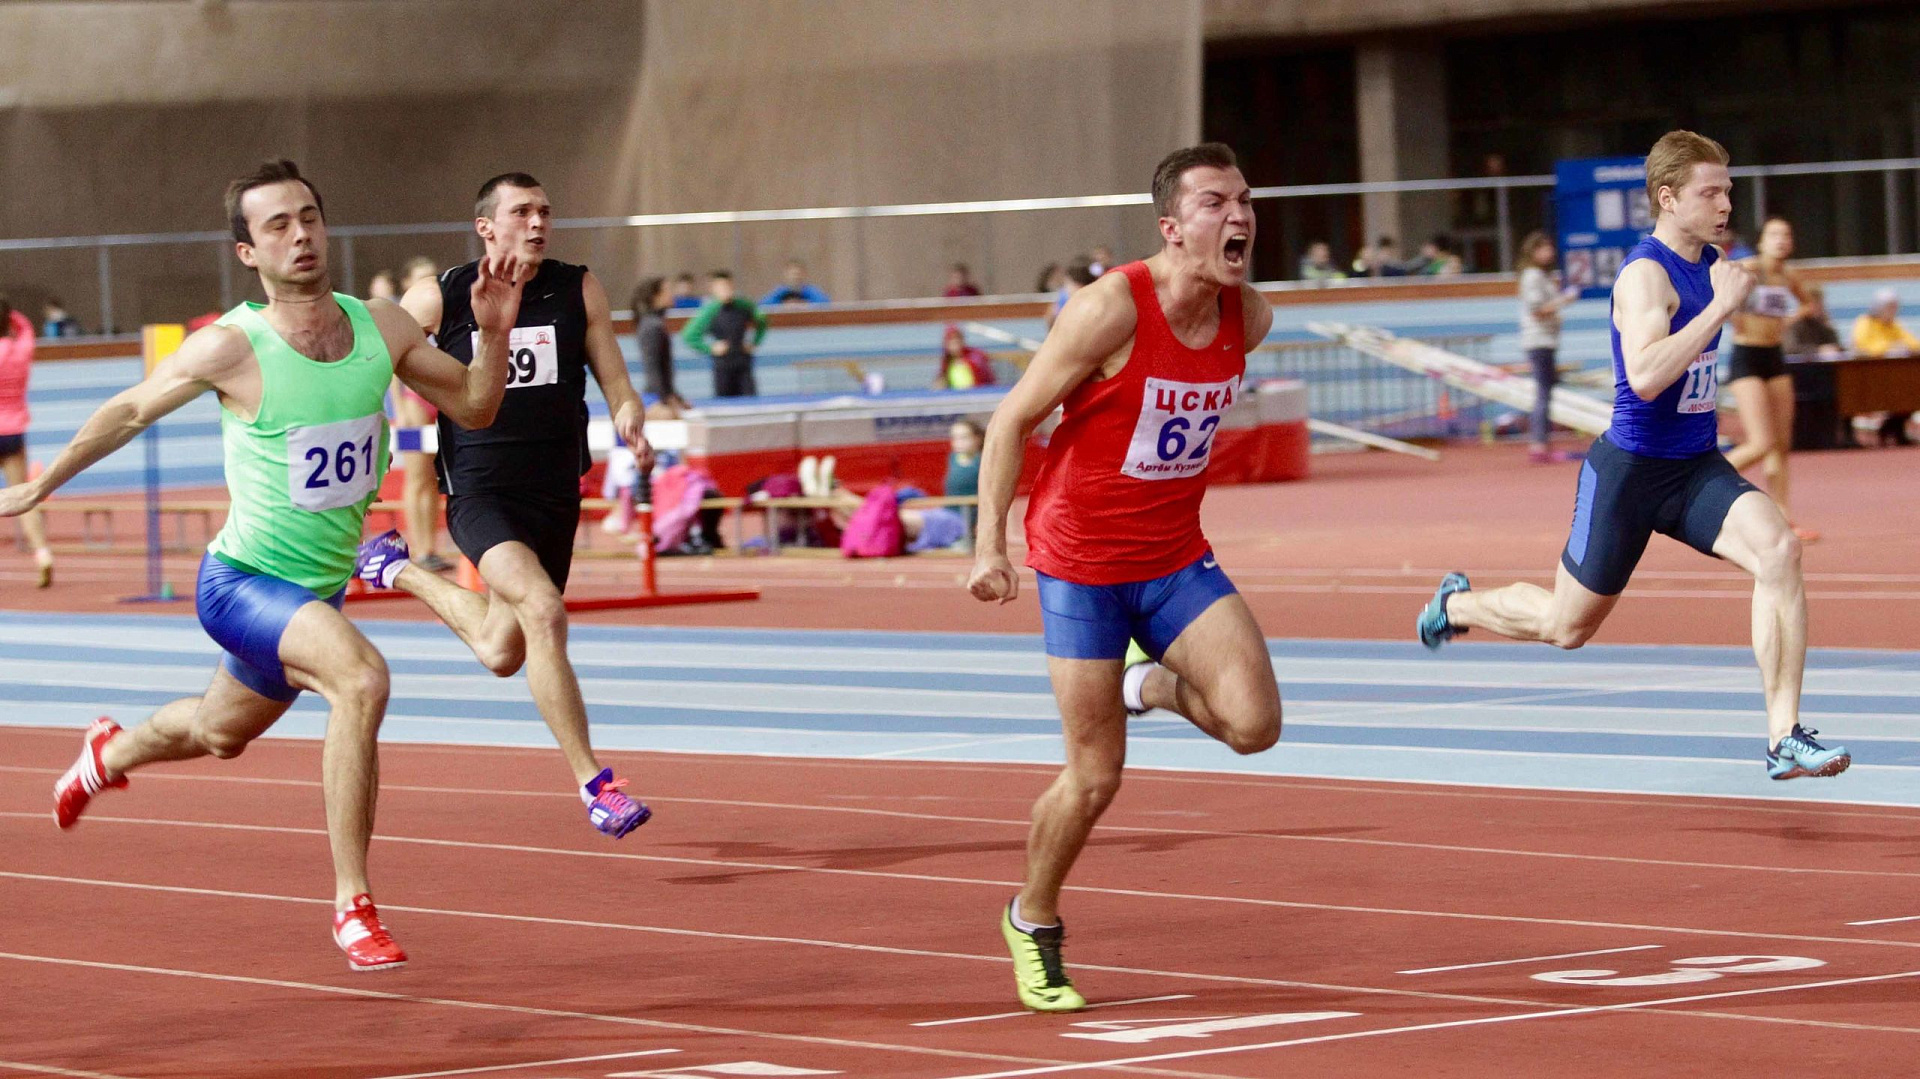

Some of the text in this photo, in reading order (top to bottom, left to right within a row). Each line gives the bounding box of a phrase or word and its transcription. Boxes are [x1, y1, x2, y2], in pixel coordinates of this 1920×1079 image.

[1155, 386, 1233, 415] ЦСКА
[1687, 362, 1717, 399] 17
[1157, 415, 1220, 461] 62
[305, 435, 373, 489] 261
